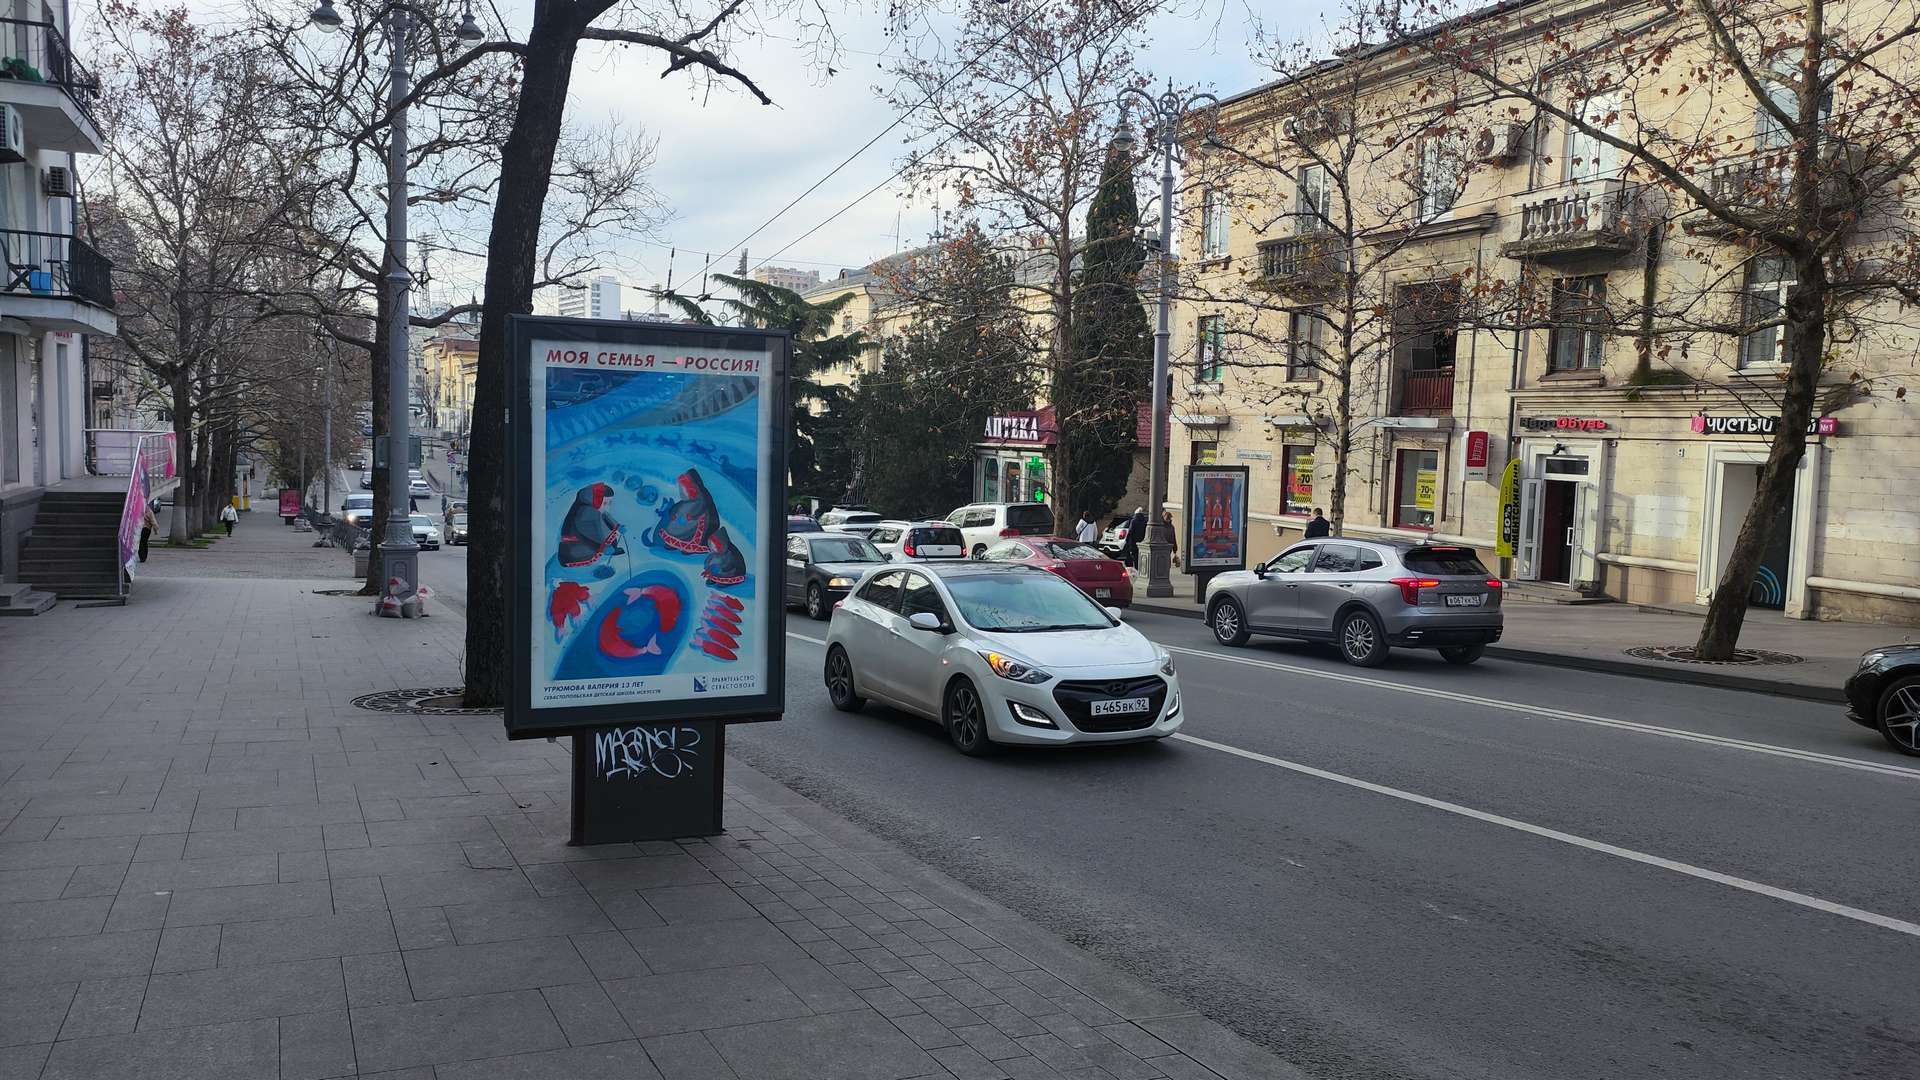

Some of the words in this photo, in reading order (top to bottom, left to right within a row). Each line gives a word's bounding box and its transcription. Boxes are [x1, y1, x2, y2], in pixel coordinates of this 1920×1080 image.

[546, 350, 589, 364] МОЯ
[597, 352, 656, 367] СЕМЬЯ
[684, 356, 760, 372] РОССИЯ!
[984, 416, 1038, 440] АПТЕКА
[544, 684, 585, 693] УГРЮМОВА
[587, 683, 619, 691] ВАЛЕРИЯ
